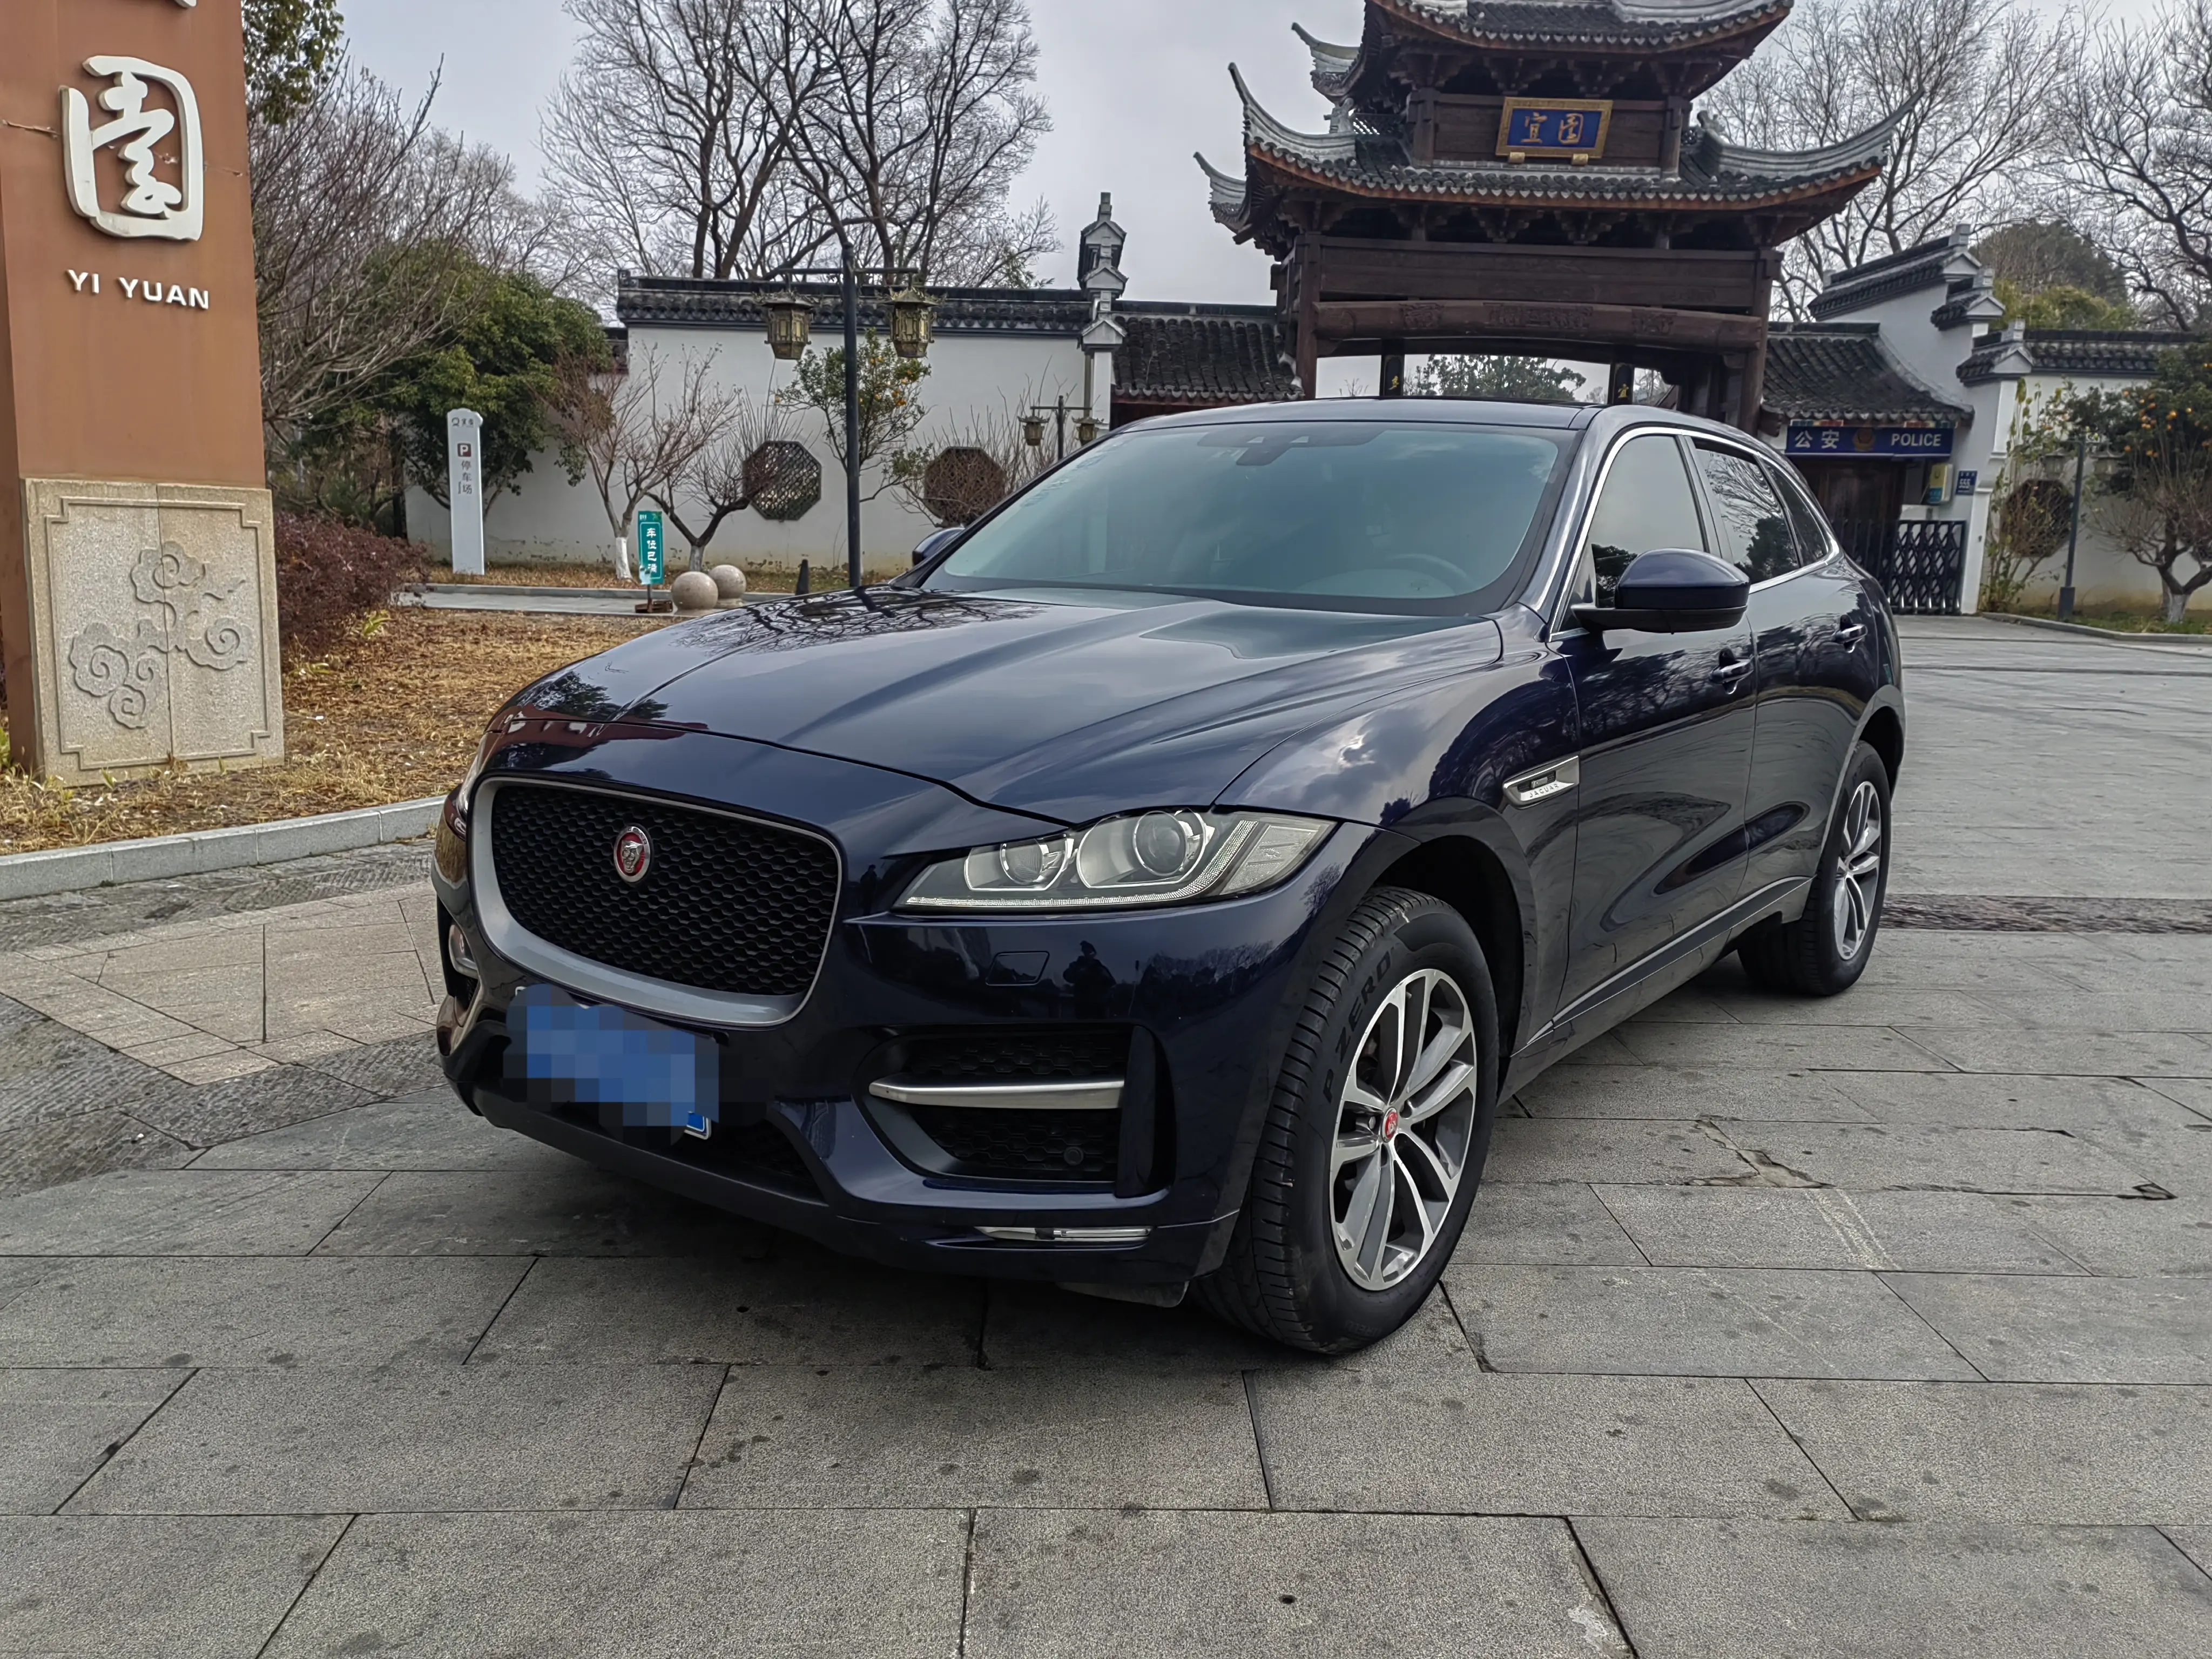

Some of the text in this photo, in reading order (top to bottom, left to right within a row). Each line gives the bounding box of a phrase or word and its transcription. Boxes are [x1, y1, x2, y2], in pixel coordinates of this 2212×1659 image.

[66, 269, 209, 309] YI YUAN
[1795, 429, 1839, 449] 公安
[1891, 433, 1941, 447] POLICE
[461, 460, 473, 494] 停车场
[646, 528, 657, 574] 车位已满
[1529, 783, 1560, 798] JAGUAR
[1323, 951, 1391, 1104] P ZERO
